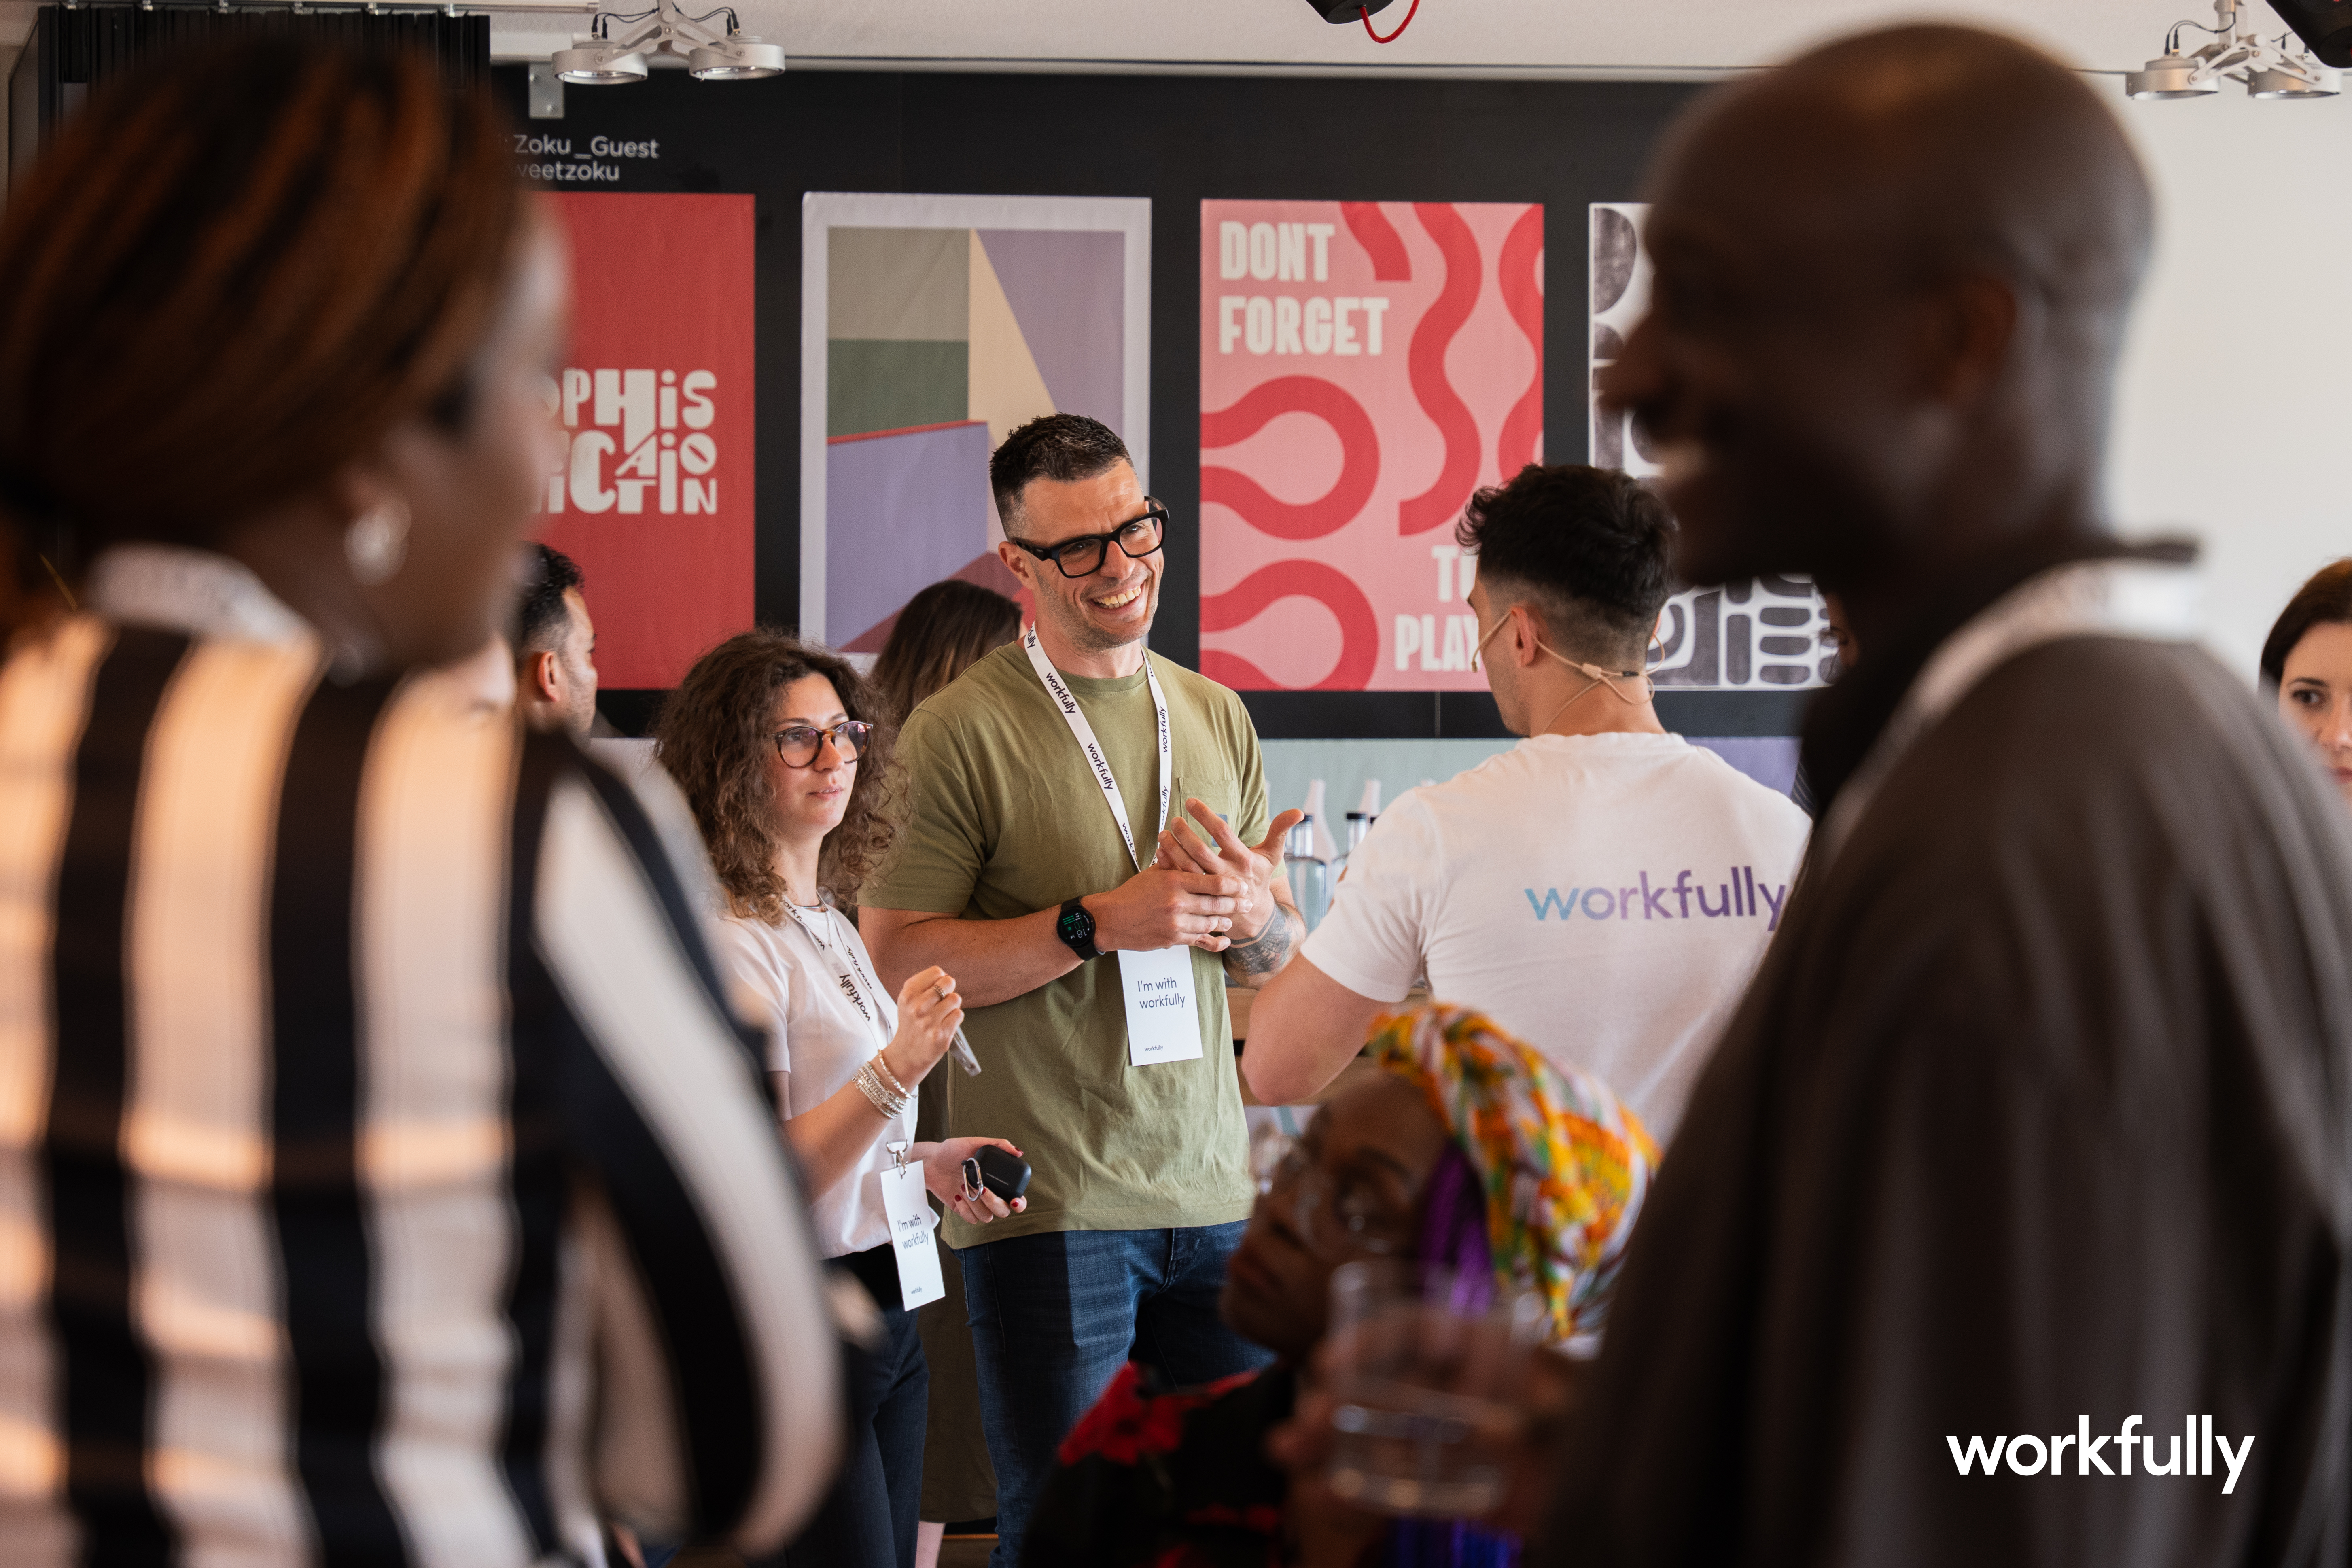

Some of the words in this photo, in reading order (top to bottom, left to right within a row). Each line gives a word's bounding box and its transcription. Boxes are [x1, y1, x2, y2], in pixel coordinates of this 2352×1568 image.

[1219, 221, 1335, 282] DONT
[1219, 295, 1390, 355] FORGET
[1046, 672, 1076, 713] workfully
[1159, 706, 1168, 753] workfully
[1087, 743, 1113, 790] workfully
[1524, 865, 1786, 932] workfully
[846, 945, 872, 989] workfully
[1137, 980, 1153, 992] I'm
[1155, 976, 1177, 990] with
[839, 974, 870, 1021] workfully
[1139, 993, 1186, 1009] workfully
[897, 1220, 908, 1232] I'm
[908, 1214, 922, 1228] with
[902, 1230, 929, 1250] workfully
